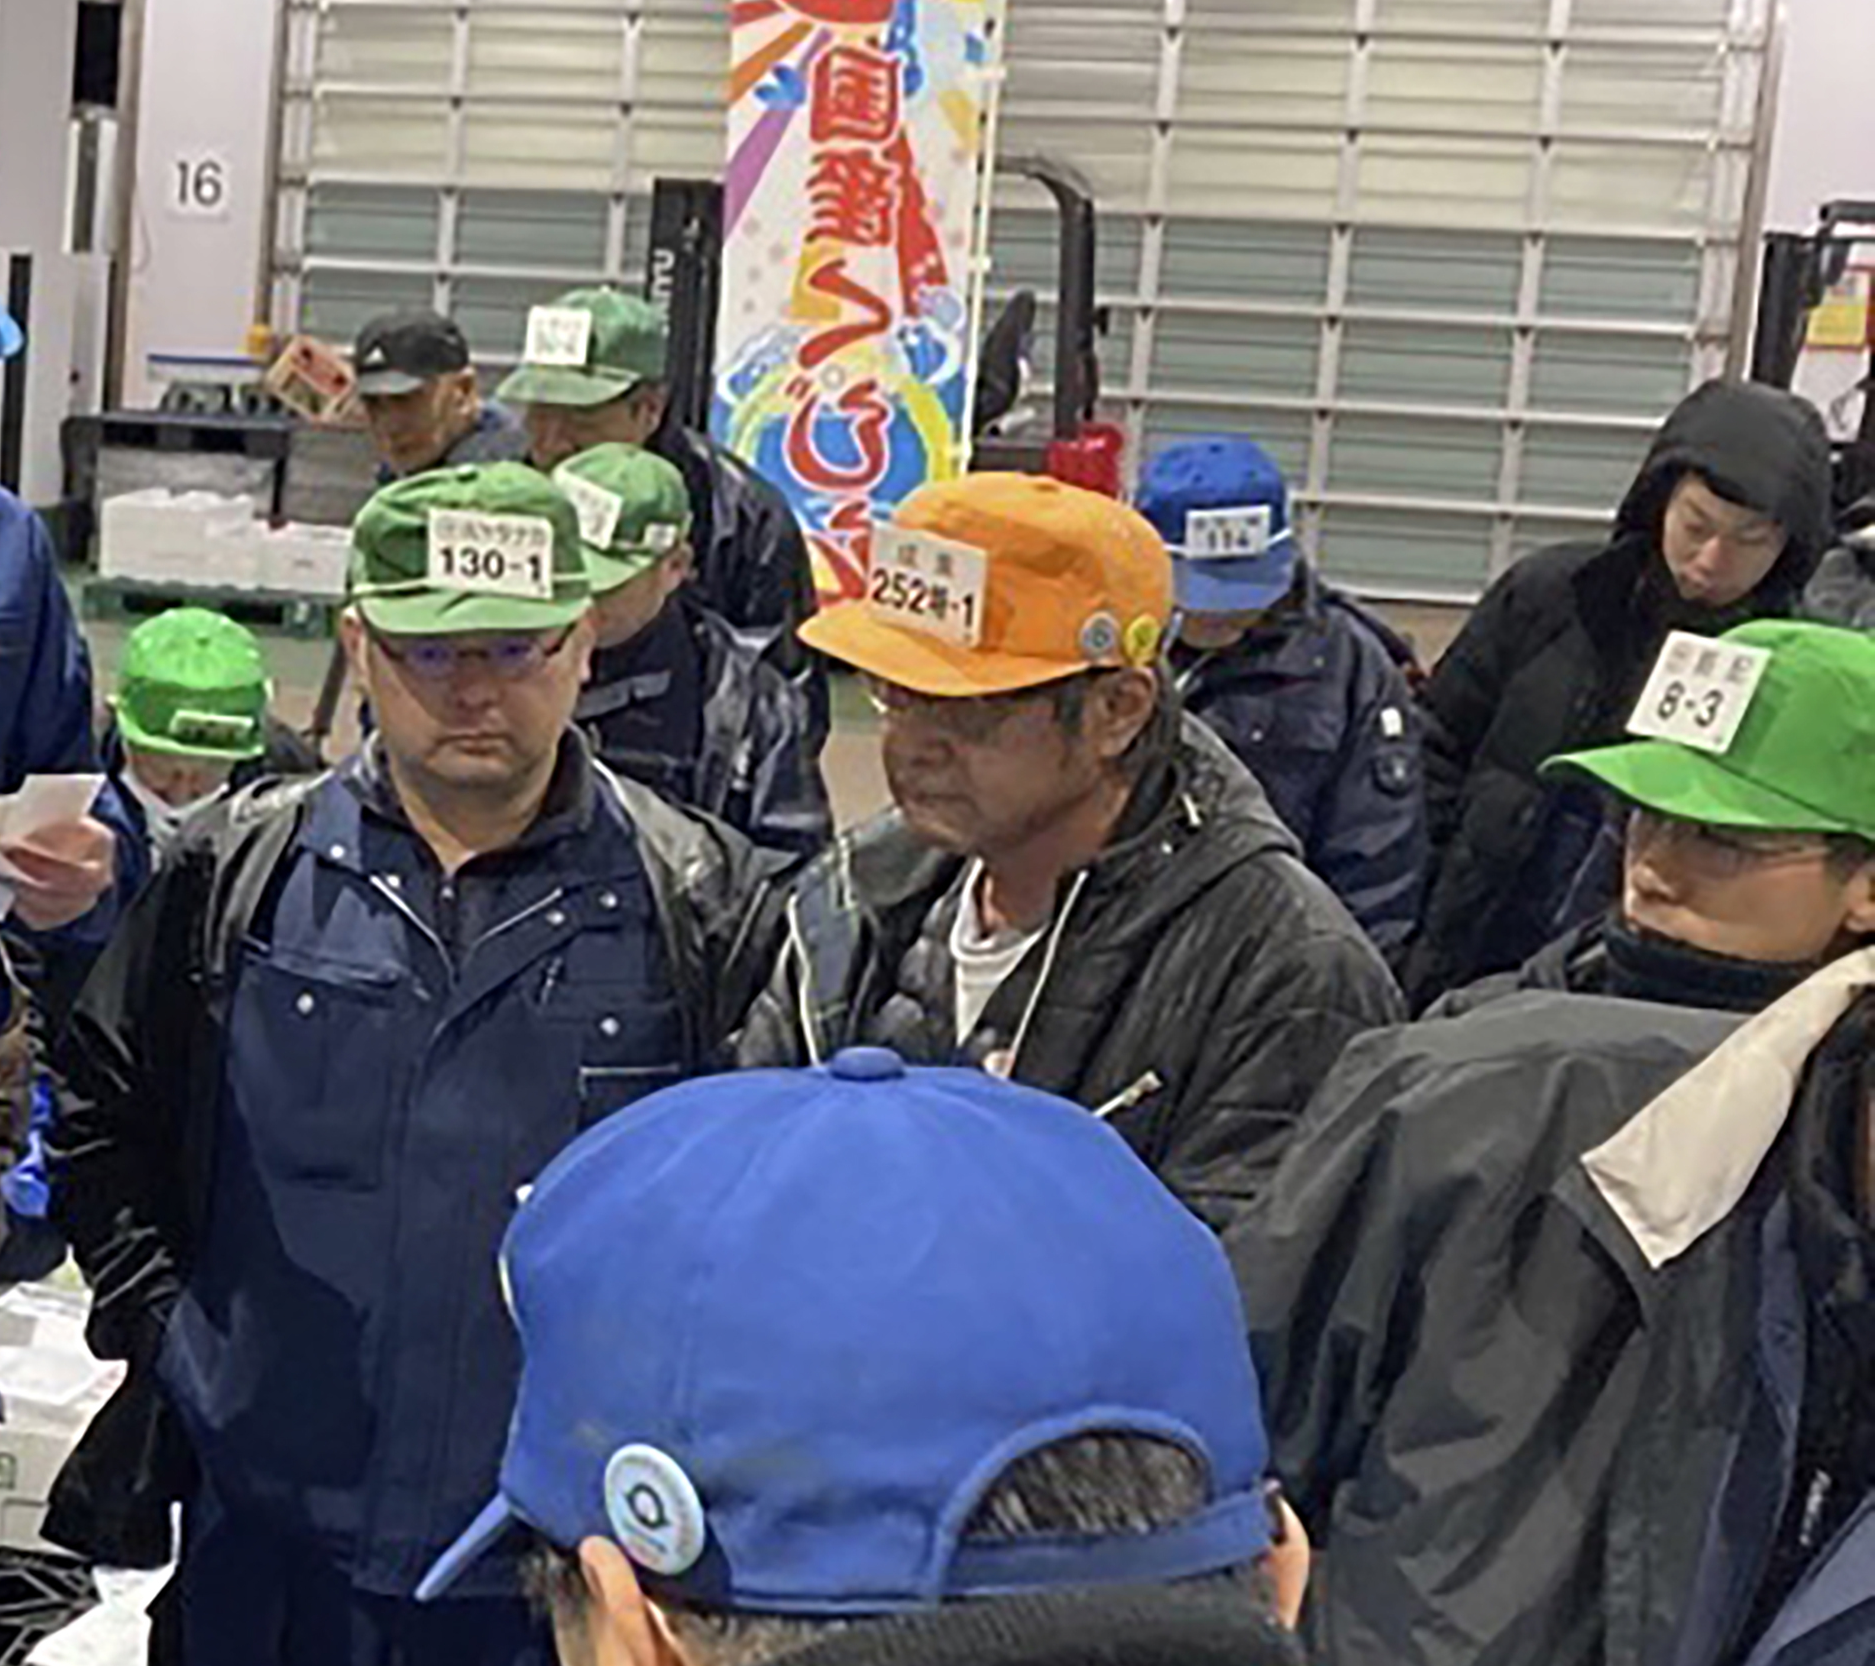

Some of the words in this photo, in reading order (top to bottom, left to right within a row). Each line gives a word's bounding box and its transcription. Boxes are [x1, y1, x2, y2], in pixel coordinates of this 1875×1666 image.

[178, 159, 223, 208] 16
[440, 546, 541, 582] 130-1
[1657, 680, 1725, 728] 8-3
